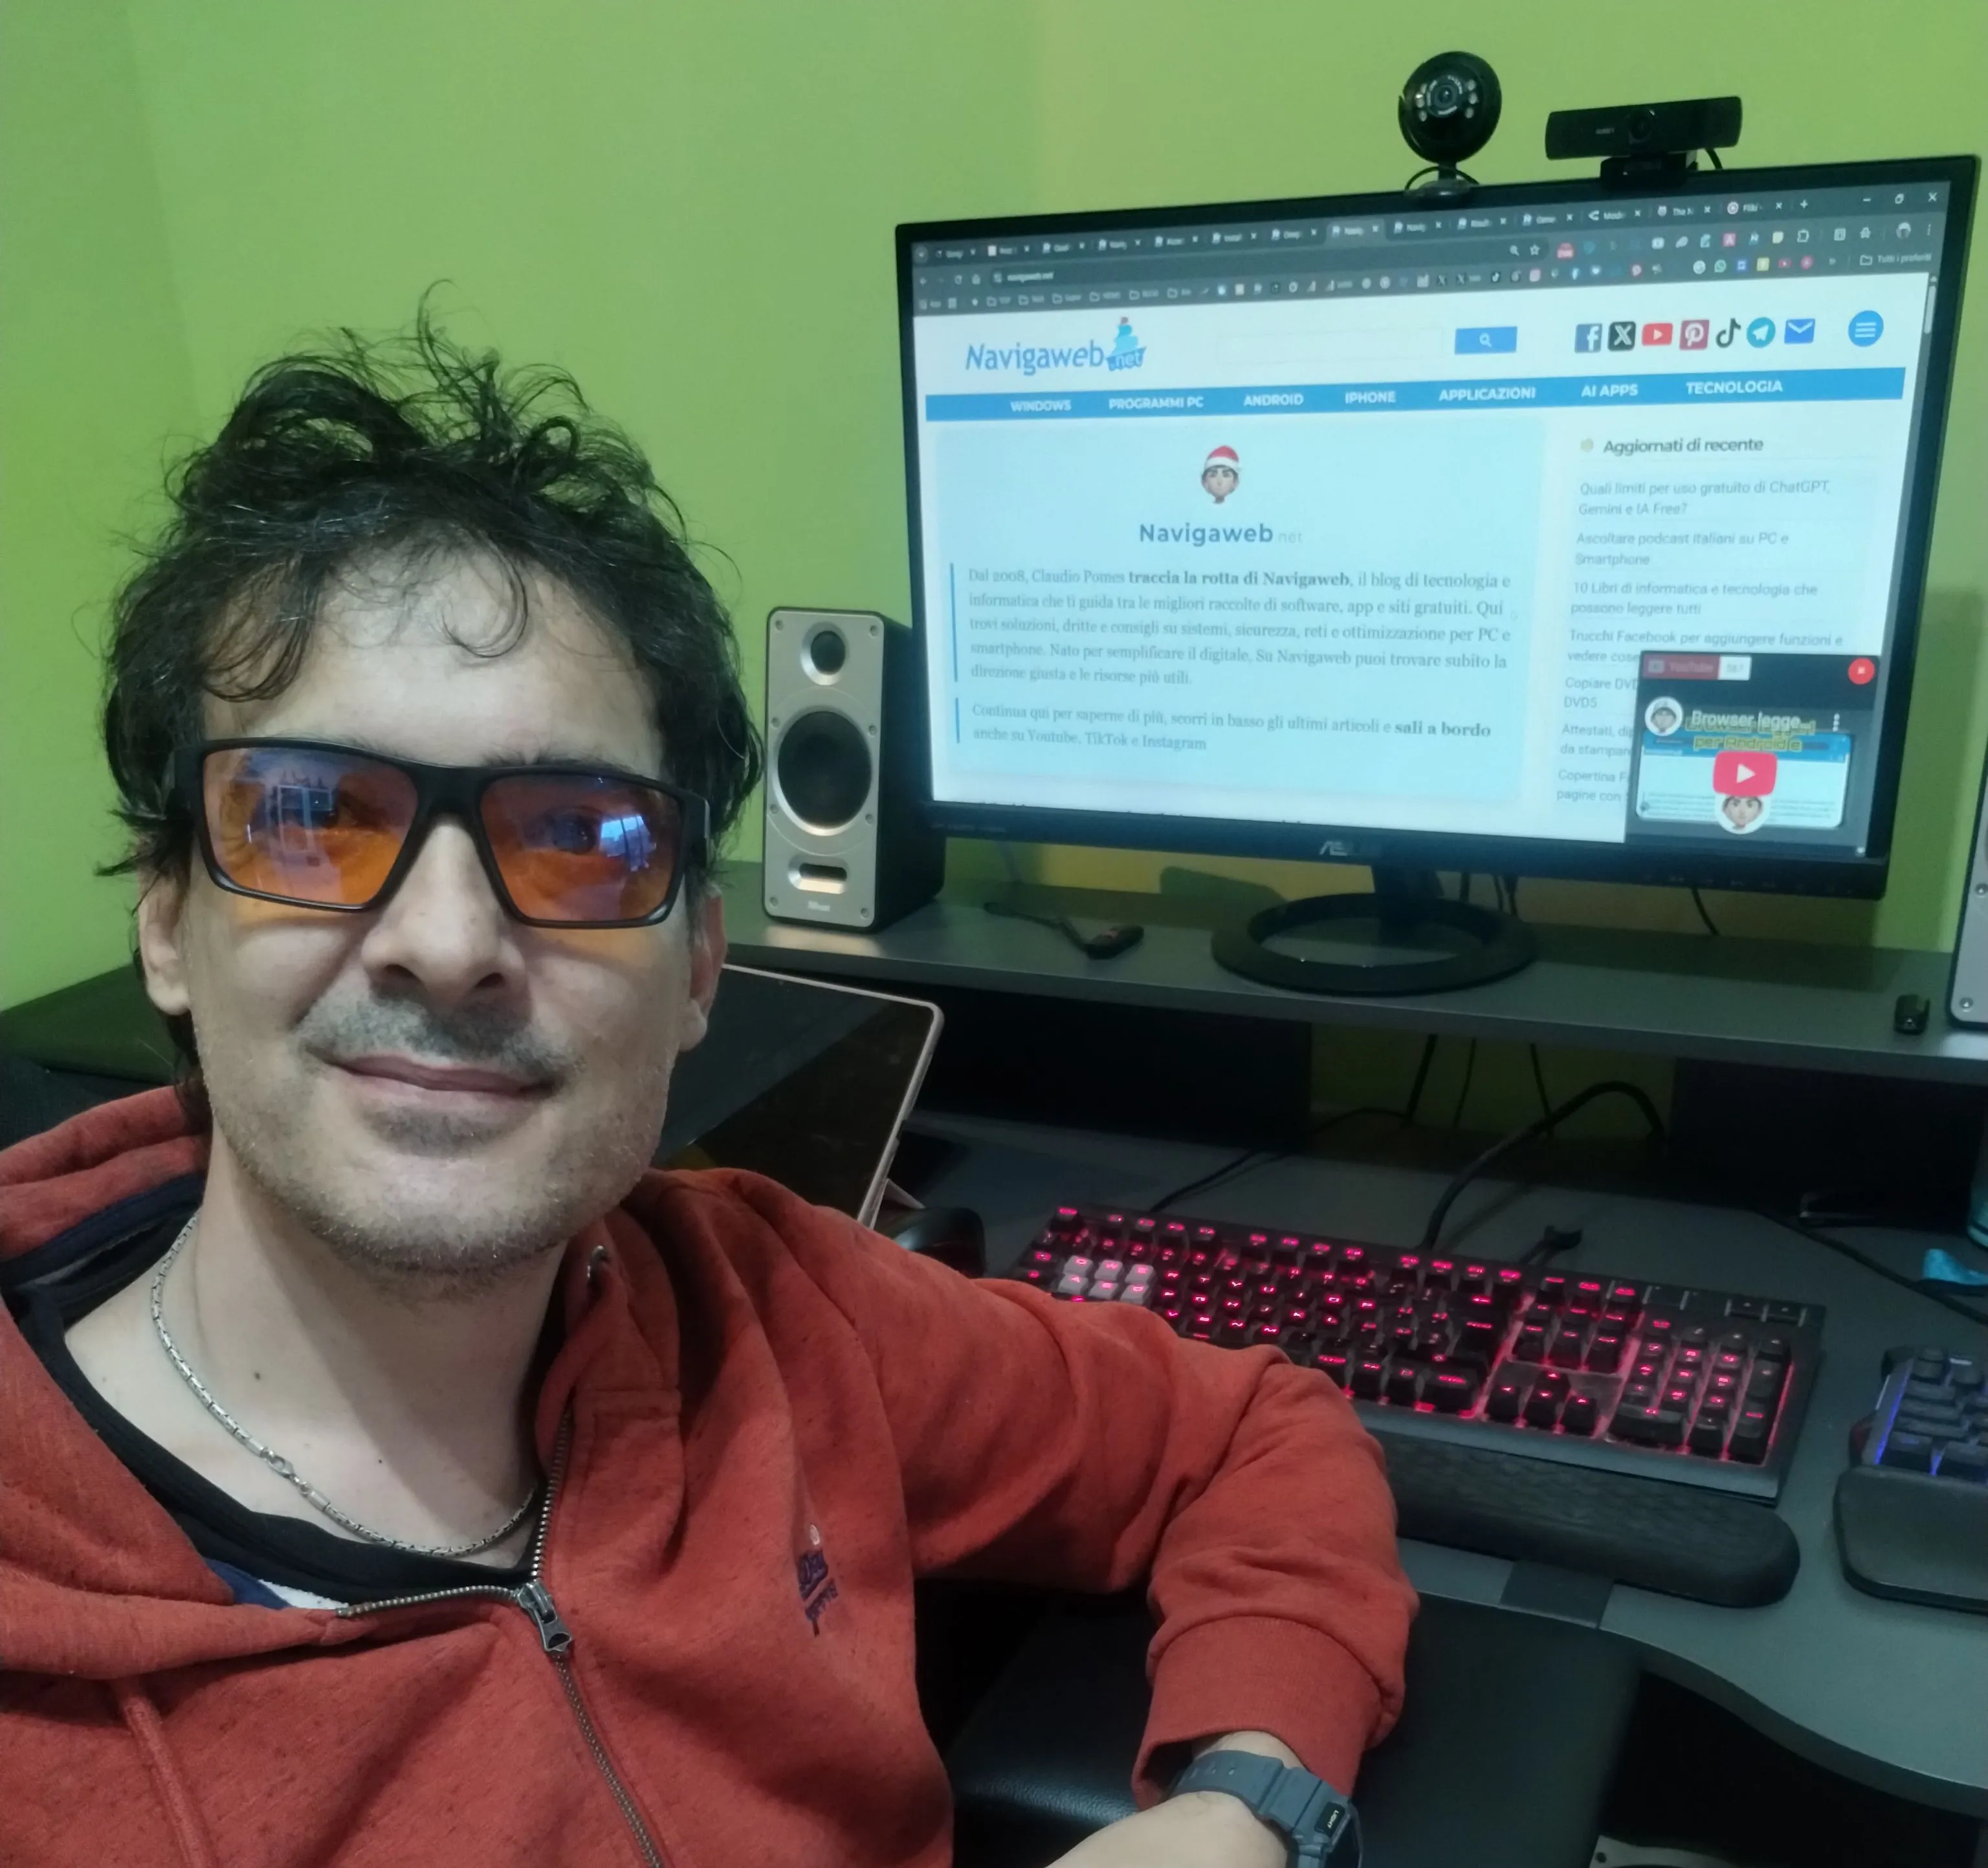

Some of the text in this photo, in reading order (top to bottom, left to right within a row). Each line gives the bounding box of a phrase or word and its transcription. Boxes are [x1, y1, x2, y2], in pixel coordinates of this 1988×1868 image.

[965, 339, 1105, 377] Navigaweb
[1438, 386, 1536, 401] APPLICAZIONI
[1581, 384, 1639, 397] AI APPS
[1685, 380, 1783, 395] TECNOLOGIA
[1010, 399, 1072, 412] WINDOWS
[1109, 395, 1204, 410] PROGRAMMI PC
[1243, 394, 1304, 406] ANDROID
[1345, 391, 1396, 405] IPHONE
[1602, 437, 1763, 457] Aggiornati di recente
[1580, 481, 1612, 496] Quali
[1615, 482, 1646, 495] limiti
[1649, 484, 1670, 497] per
[1673, 484, 1696, 495] uso
[1700, 482, 1751, 497] gratuito
[1754, 479, 1765, 494] di
[1578, 503, 1622, 515] Gemini
[1625, 506, 1633, 515] e
[1653, 502, 1688, 515] Free?
[1139, 522, 1274, 548] Navigaweb
[1576, 531, 1789, 546] Ascoltare podcast su PC e
[1574, 553, 1650, 566] Smartphone
[969, 568, 989, 582] Dal
[993, 570, 1029, 584] 2008,
[1032, 570, 1080, 583] Claudio
[1129, 570, 1180, 584] traccia
[1184, 570, 1197, 584] la
[1202, 572, 1239, 584] rotta
[1243, 570, 1258, 585] di
[1263, 572, 1353, 590] Navigaweb,
[1359, 572, 1366, 586] il
[1371, 572, 1401, 590] blog
[1405, 572, 1419, 587] di
[1424, 572, 1497, 591] tecnologia
[1502, 576, 1511, 588] e
[1574, 582, 1818, 598] 10 Libri di informatica e tecnologia che
[969, 592, 1503, 619] informatica che ti guida tra le migliori raccolte di software, app e siti gratuiti. Qui
[1571, 602, 1701, 616] possono leggere tutti
[970, 617, 1511, 645] trovi soluzioni, dritte e consigli su sistemi, sicurezza, reti e ottimizzazione per PC e
[1570, 629, 1843, 647] Trucchi Facebook per aggiungere funzioni e
[1050, 643, 1080, 656] Nato
[1083, 647, 1103, 661] per
[1107, 645, 1184, 662] semplificare
[1189, 646, 1196, 660] il
[1256, 649, 1272, 663] Su
[1277, 649, 1351, 667] Navigaweb
[1355, 652, 1386, 669] puoi
[1391, 653, 1441, 667] trovare
[1445, 653, 1490, 668] subito
[1494, 654, 1507, 669] la
[1567, 650, 1607, 662] vedere
[971, 663, 1026, 679] direzione
[1030, 667, 1066, 682] giusta
[1070, 670, 1077, 680] e
[1079, 668, 1090, 681] le
[1094, 669, 1136, 682] risorse
[1565, 677, 1611, 690] Copiare
[1563, 696, 1597, 708] DVD5
[973, 704, 1026, 718] Continua
[1030, 706, 1049, 722] qui
[1053, 709, 1072, 722] per
[1076, 710, 1124, 724] saperne
[1127, 708, 1140, 723] di
[1171, 712, 1207, 726] scorri
[1211, 712, 1224, 726] in
[1228, 713, 1264, 728] basso
[1267, 714, 1283, 732] gli
[1287, 716, 1327, 731] ultimi
[1332, 718, 1380, 733] articoli
[1383, 722, 1391, 733] e
[1395, 720, 1423, 735] sali
[1427, 724, 1437, 735] a
[1441, 721, 1491, 737] bordo
[1692, 709, 1754, 727] Browser
[973, 727, 1008, 740] anche
[1011, 730, 1024, 741] su
[1085, 731, 1127, 746] TikTok
[1131, 735, 1139, 746] e
[1142, 735, 1206, 752] Instagram
[1560, 744, 1574, 755] da
[1558, 769, 1616, 783] Copertina
[1556, 790, 1621, 803] pagine con
